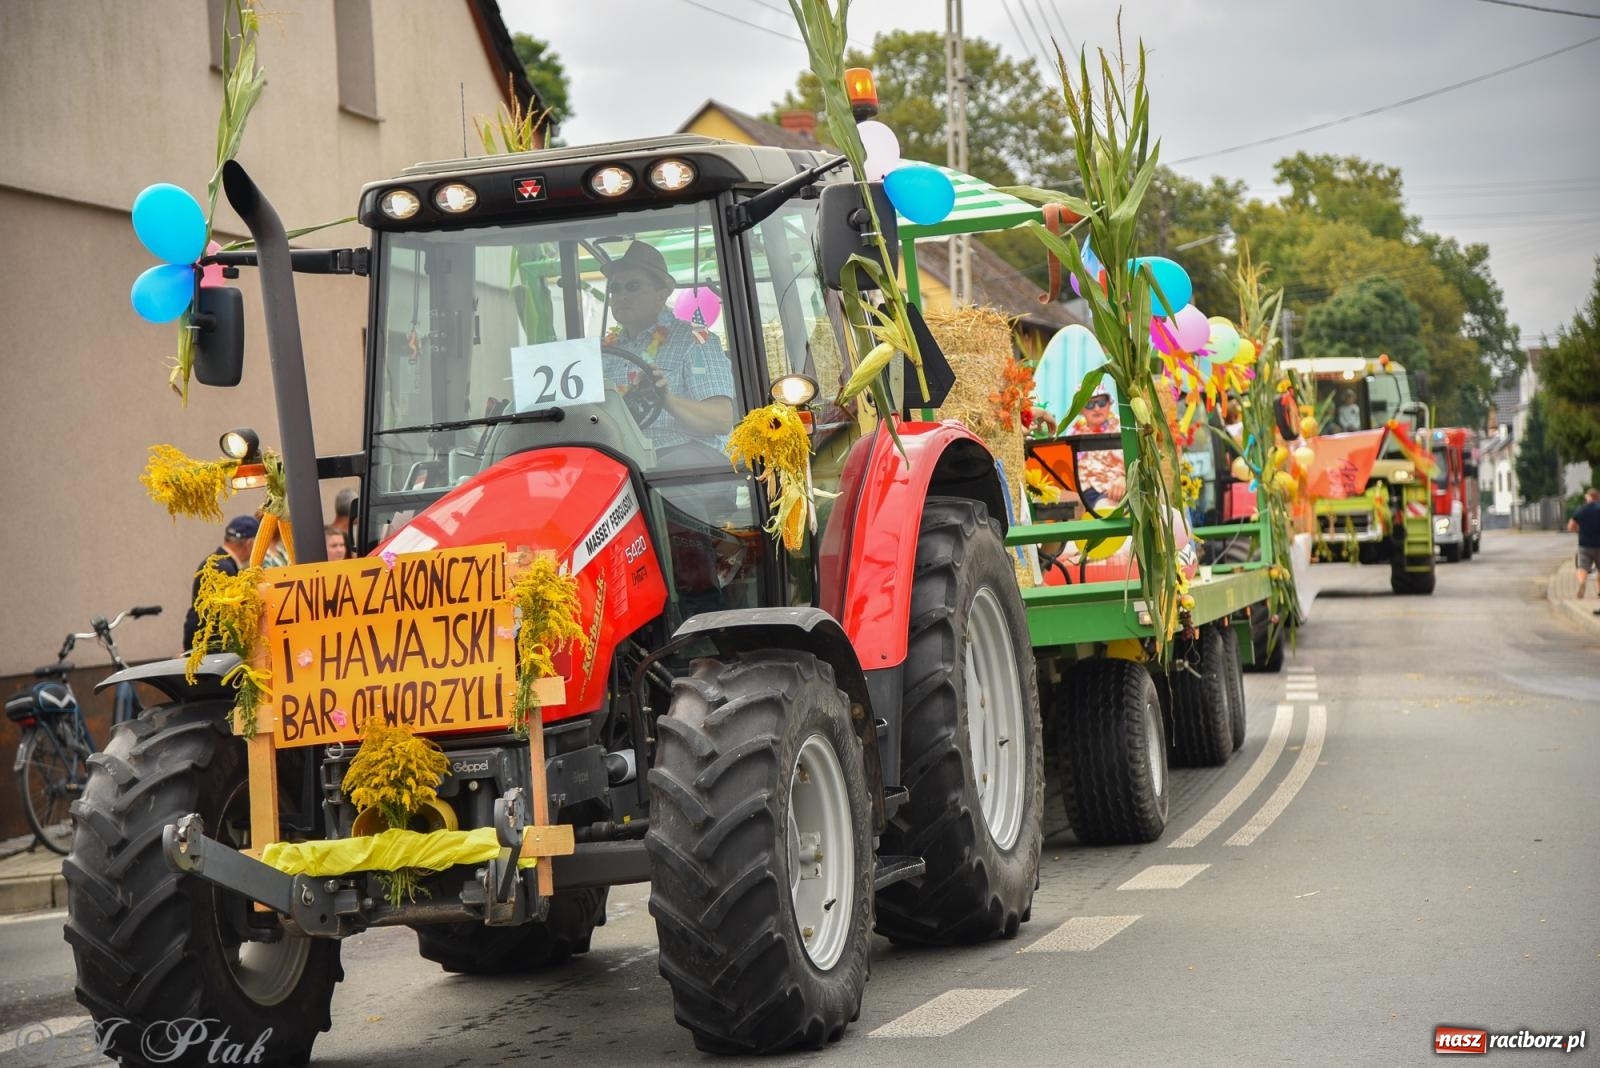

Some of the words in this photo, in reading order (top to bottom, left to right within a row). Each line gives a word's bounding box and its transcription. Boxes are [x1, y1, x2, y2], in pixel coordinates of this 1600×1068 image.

[533, 360, 584, 404] 26
[585, 519, 613, 557] MASSEY
[610, 491, 635, 532] FERGUSON
[625, 535, 647, 564] 5420
[274, 570, 359, 626] ŻNIWA
[360, 551, 507, 616] ZAKOŃCZYLI
[320, 608, 495, 682] HAWAJSKI
[281, 688, 338, 742] BAR
[352, 666, 504, 736] OTWORZYLI
